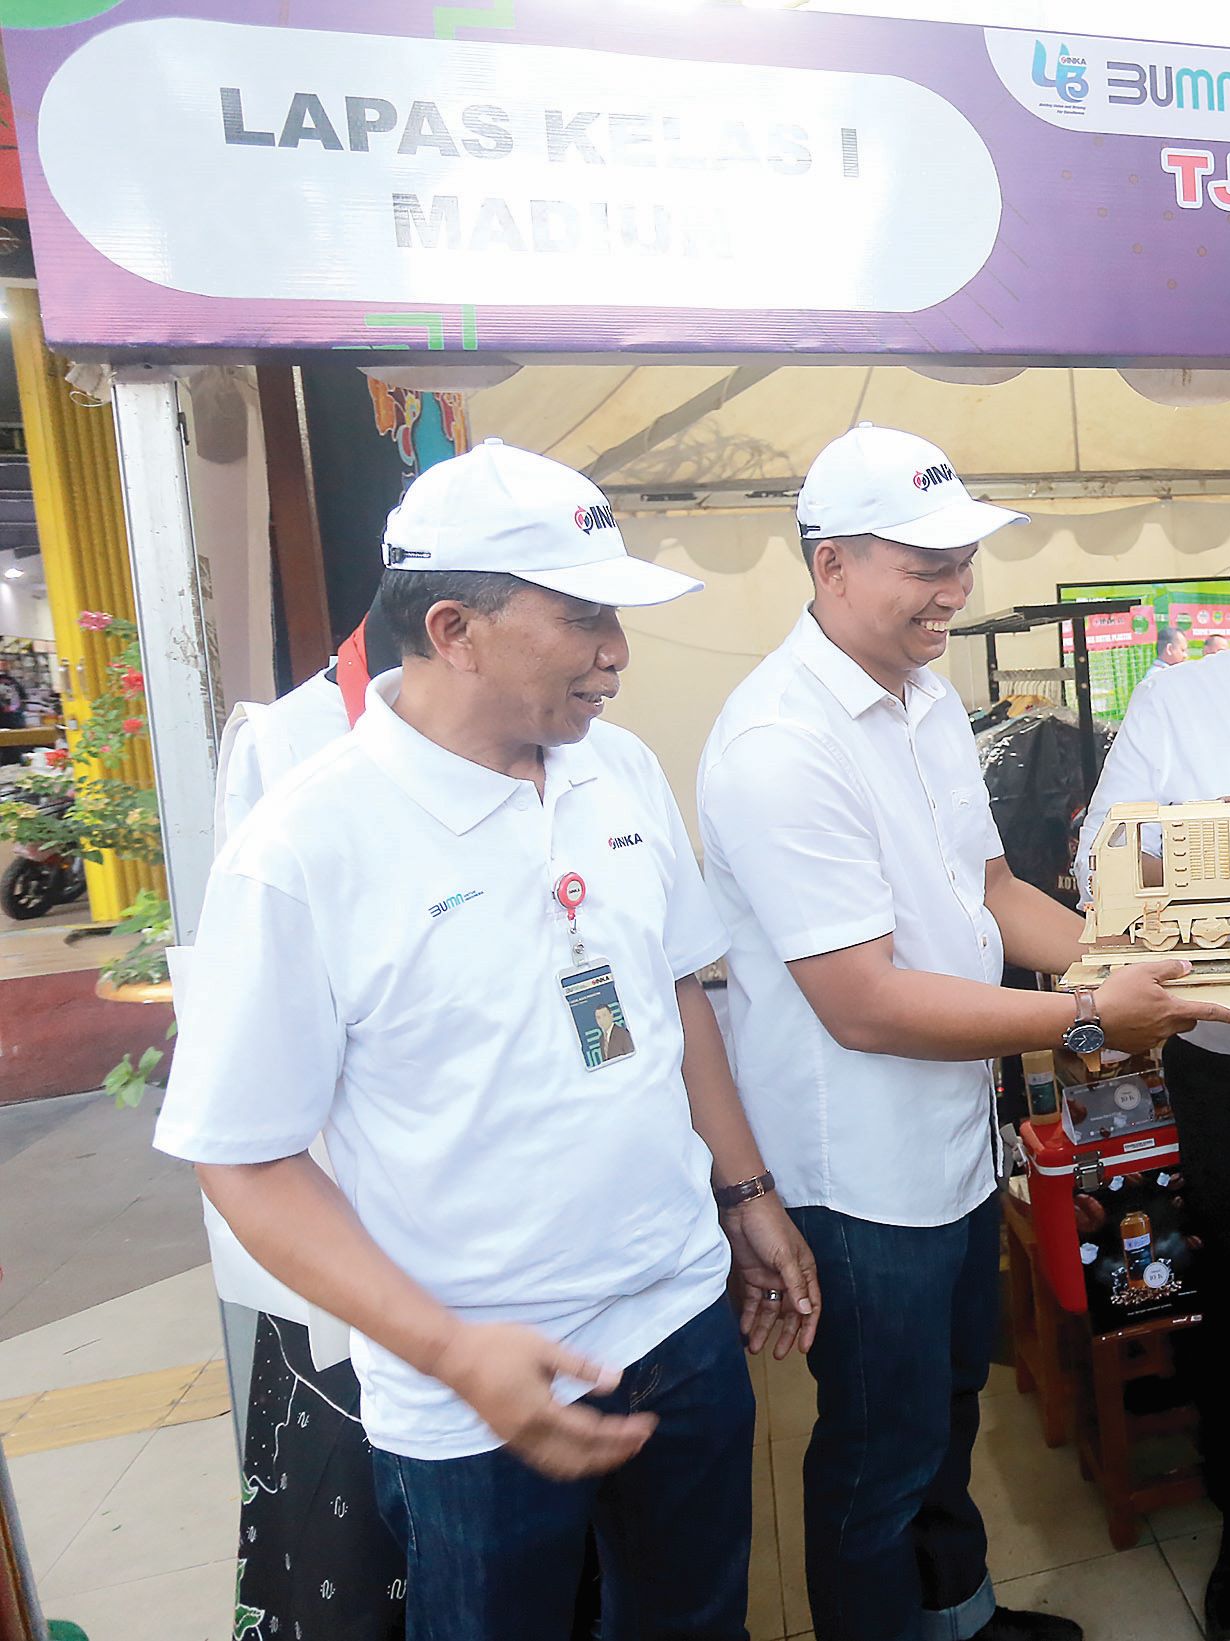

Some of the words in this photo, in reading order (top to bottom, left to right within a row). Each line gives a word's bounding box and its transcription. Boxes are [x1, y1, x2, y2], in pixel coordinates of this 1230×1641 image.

[219, 87, 514, 160] LAPAS
[840, 128, 860, 178] I
[614, 832, 643, 849] INKA
[428, 893, 465, 918] BUMN
